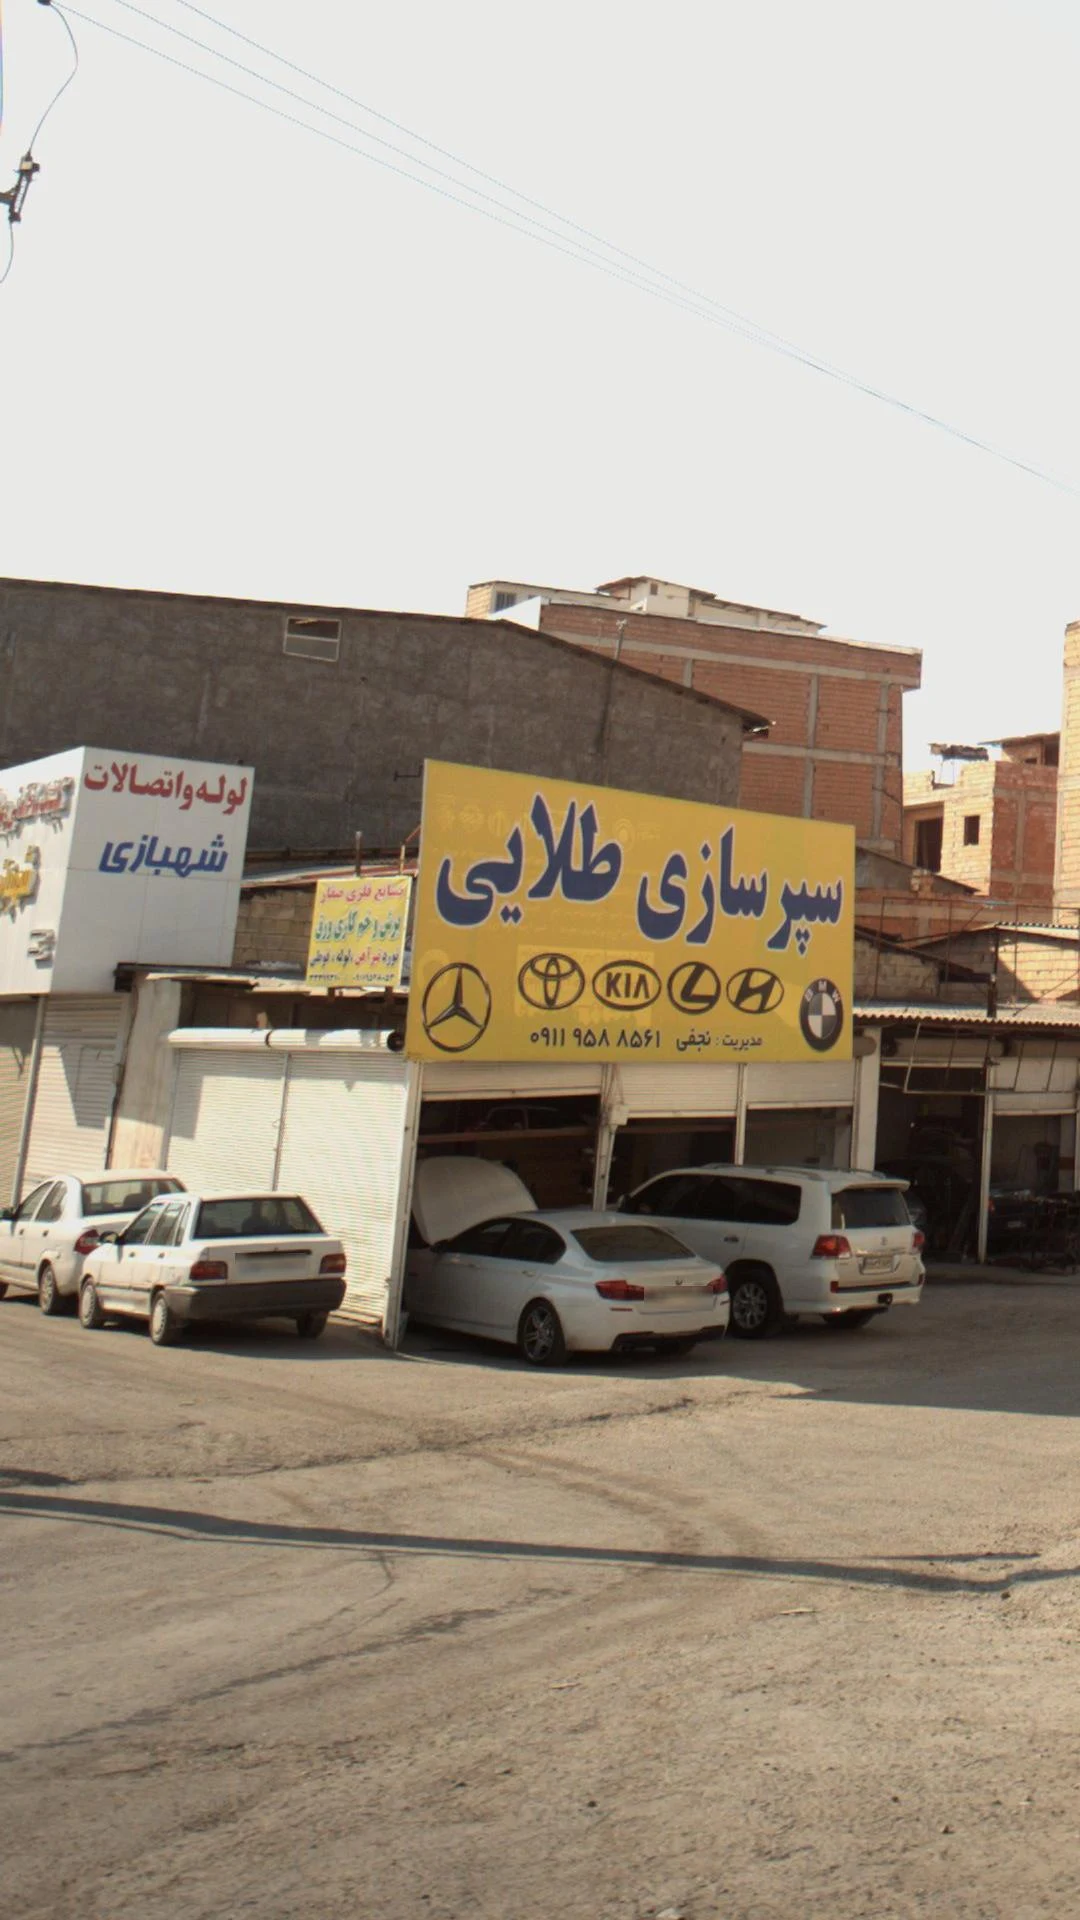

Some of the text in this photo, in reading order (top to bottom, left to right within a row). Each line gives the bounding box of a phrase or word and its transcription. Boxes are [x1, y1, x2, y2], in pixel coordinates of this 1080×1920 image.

[196, 774, 248, 815] لوله
[98, 833, 229, 878] شهبازی
[435, 793, 844, 956] سپر سازی طلایی
[606, 971, 650, 999] KIA
[804, 980, 841, 1003] BMW
[572, 1026, 611, 1048] ۹۵۸
[616, 1029, 661, 1049] ۸۵۶۱
[675, 1028, 712, 1052] نجفی
